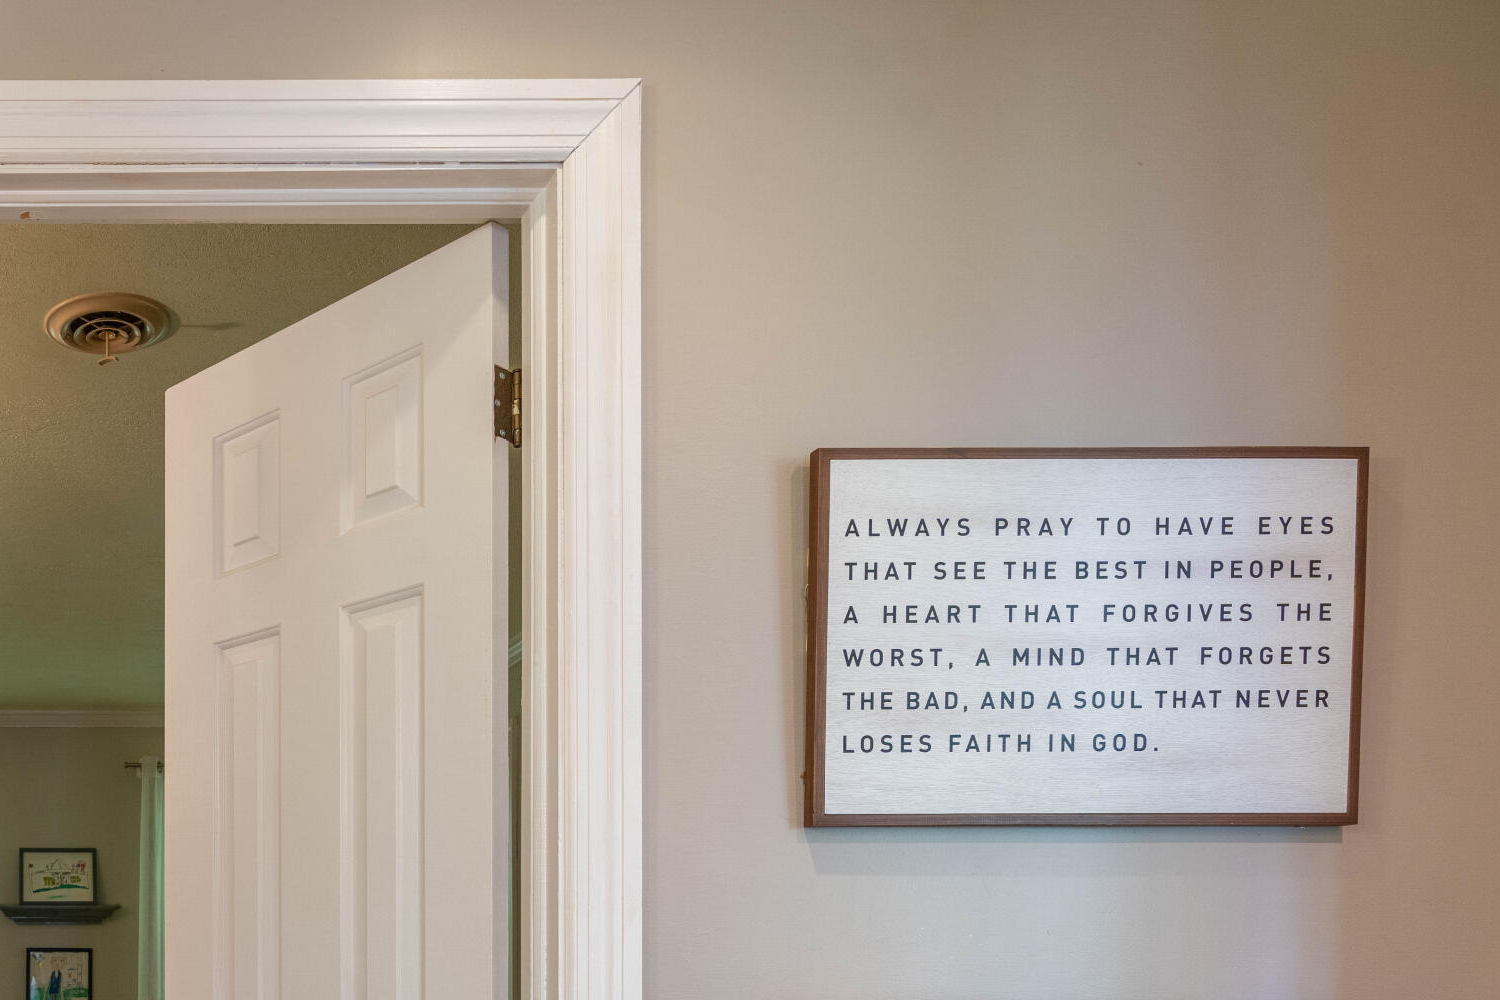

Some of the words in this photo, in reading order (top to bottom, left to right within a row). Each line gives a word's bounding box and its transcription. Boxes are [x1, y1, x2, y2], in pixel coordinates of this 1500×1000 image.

[844, 517, 973, 538] ALWAYS
[994, 517, 1075, 537] PRAY
[1096, 517, 1132, 536] TO
[1154, 516, 1235, 536] HAVE
[1257, 516, 1335, 536] EYES
[845, 561, 917, 581] THAT
[933, 561, 988, 580] SEE
[1003, 560, 1058, 580] THE
[1075, 560, 1147, 580] BEST
[1163, 560, 1192, 579] IN
[1209, 559, 1334, 582] PEOPLE,
[843, 605, 859, 624] A
[882, 604, 982, 624] HEART
[1004, 604, 1079, 623] THAT
[1102, 603, 1254, 623] FORGIVES
[1277, 602, 1333, 622] THE
[843, 647, 956, 670] WORST,
[974, 647, 990, 667] A
[1011, 647, 1086, 666] MIND
[1106, 646, 1179, 666] THAT
[1199, 646, 1331, 665] FORGETS
[842, 691, 894, 711] THE
[905, 691, 968, 714] BAD,
[980, 690, 1035, 710] AND
[1046, 690, 1063, 710] A
[1073, 689, 1142, 709] SOUL
[1155, 689, 1222, 709] THAT
[1234, 689, 1330, 709] NEVER
[842, 734, 933, 753] LOSES
[948, 734, 1033, 753] FAITH
[1048, 733, 1076, 753] IN
[1091, 733, 1159, 753] GOD.
